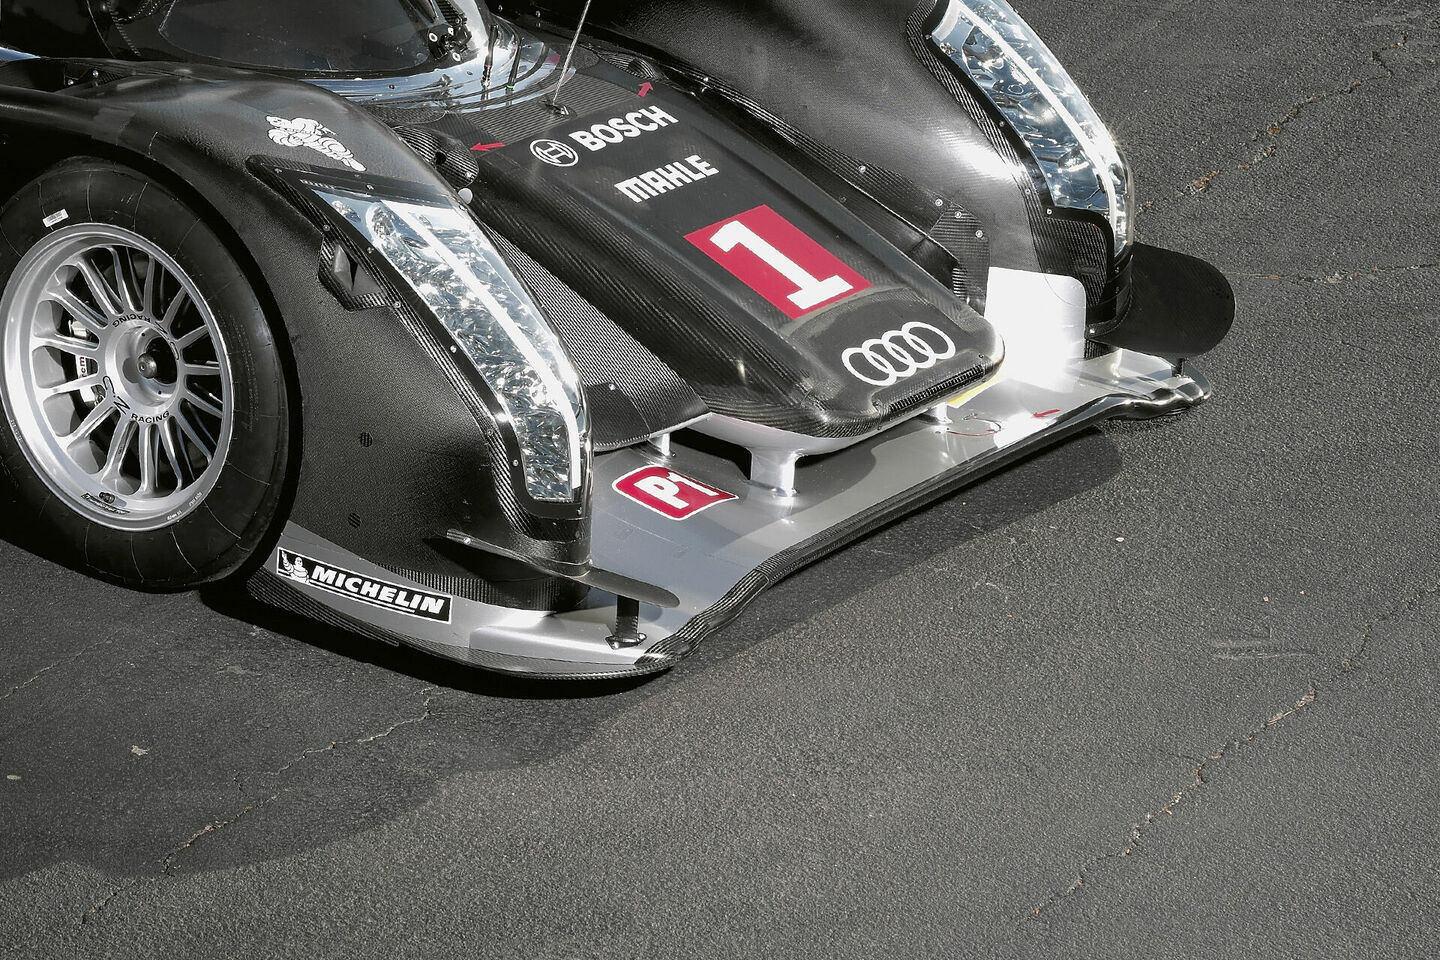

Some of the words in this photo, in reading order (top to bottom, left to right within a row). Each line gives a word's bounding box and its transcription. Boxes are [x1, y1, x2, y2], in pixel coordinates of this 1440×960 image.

[568, 105, 679, 152] BOSCH
[613, 154, 720, 204] MAHLE
[709, 220, 854, 310] 1
[130, 410, 170, 424] RACING
[633, 471, 720, 510] P1
[311, 565, 444, 615] MICHELIN
